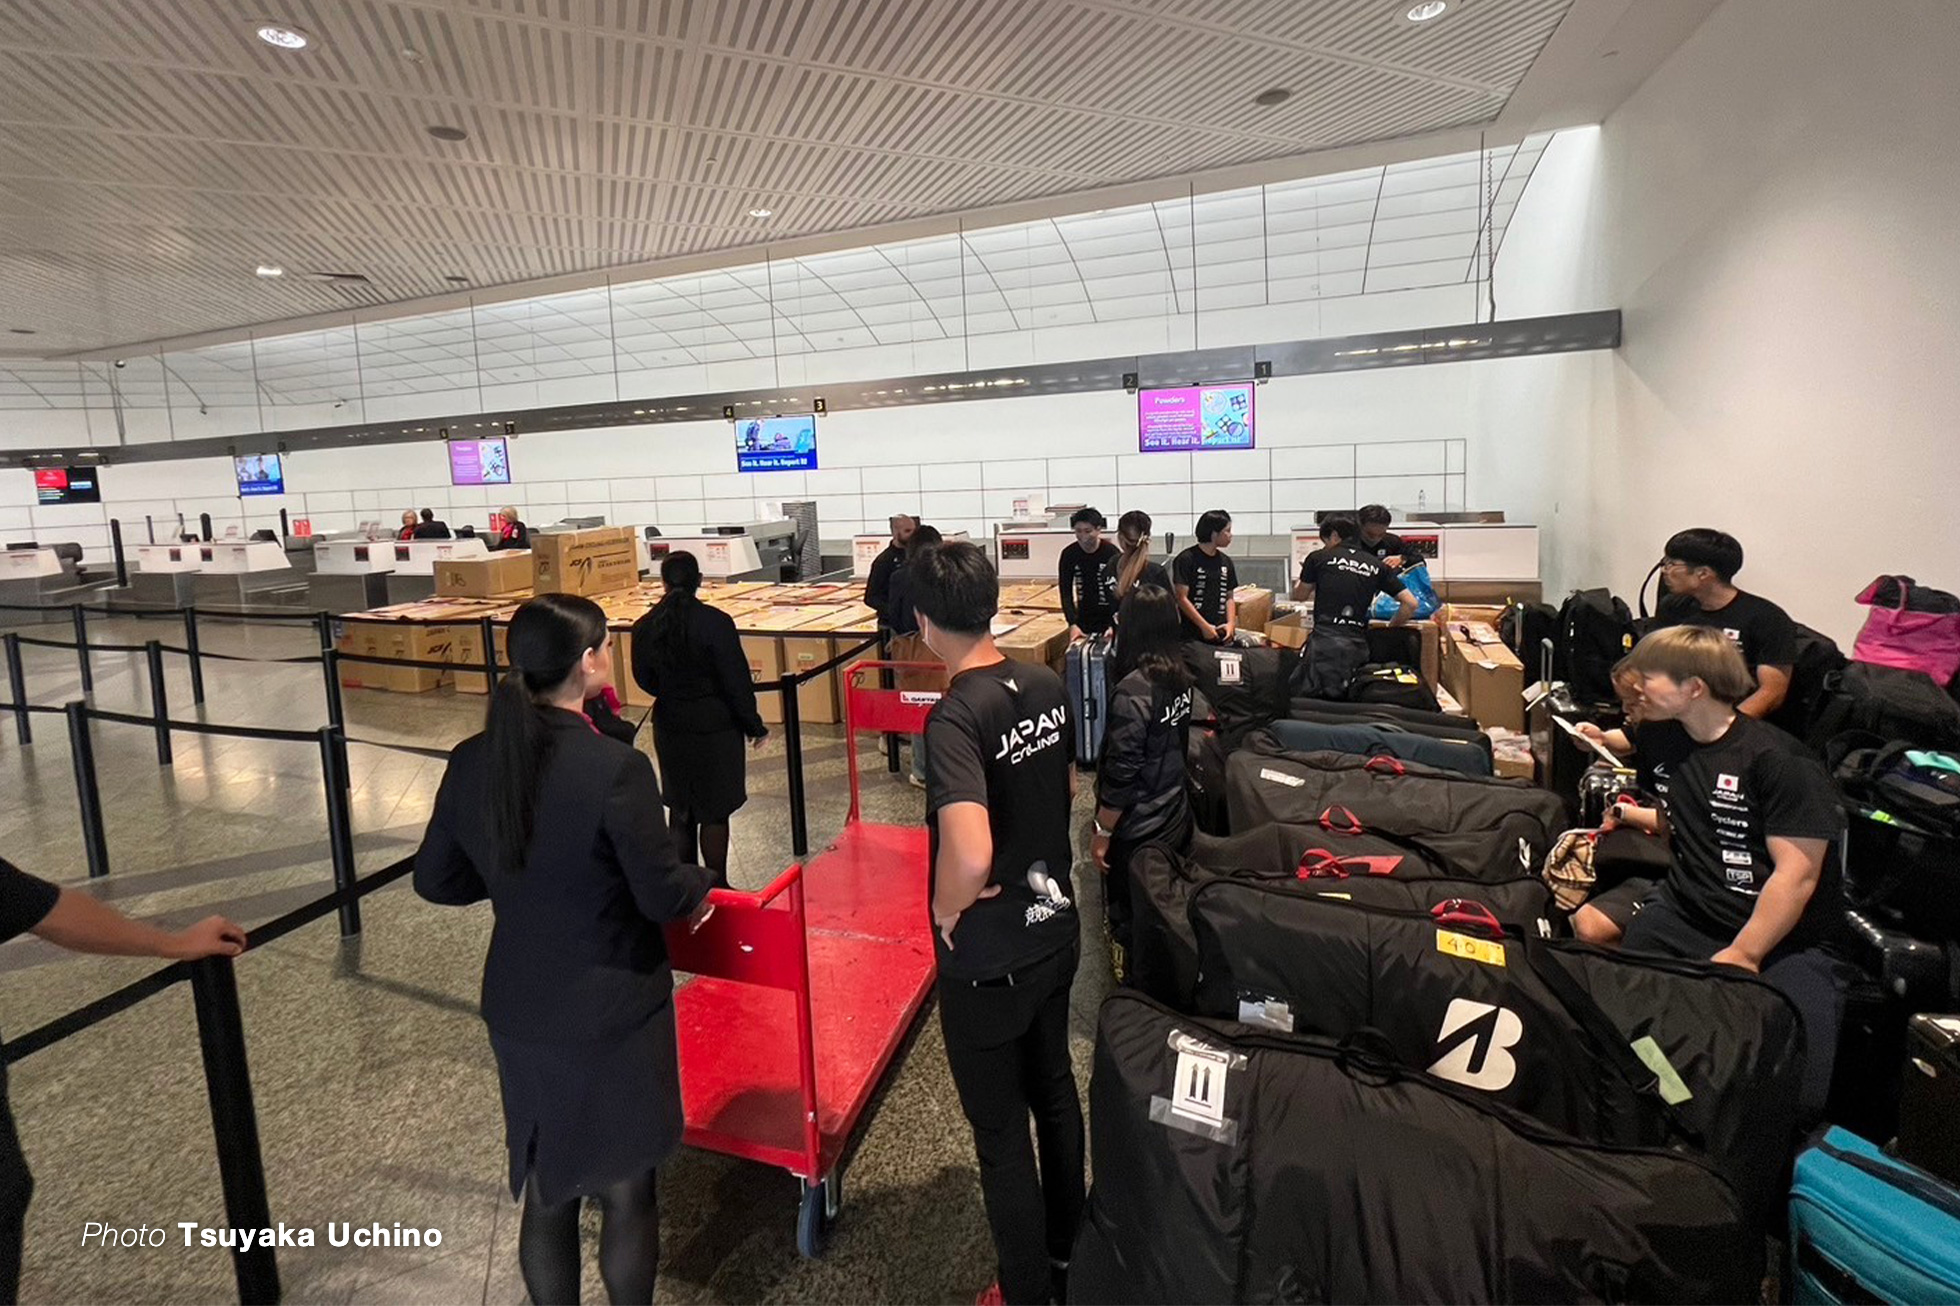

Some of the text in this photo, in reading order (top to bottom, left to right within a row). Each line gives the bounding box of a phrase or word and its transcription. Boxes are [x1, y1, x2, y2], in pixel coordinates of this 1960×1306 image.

[1262, 366, 1267, 375] 1
[1126, 375, 1133, 385] 2
[1154, 396, 1185, 404] Powders
[816, 401, 824, 411] 3
[725, 408, 732, 416] 4
[1144, 438, 1159, 447] See
[1161, 437, 1170, 446] it.
[1171, 436, 1189, 445] Hear
[1327, 557, 1379, 575] JAPAN
[995, 705, 1066, 760] JAPAN
